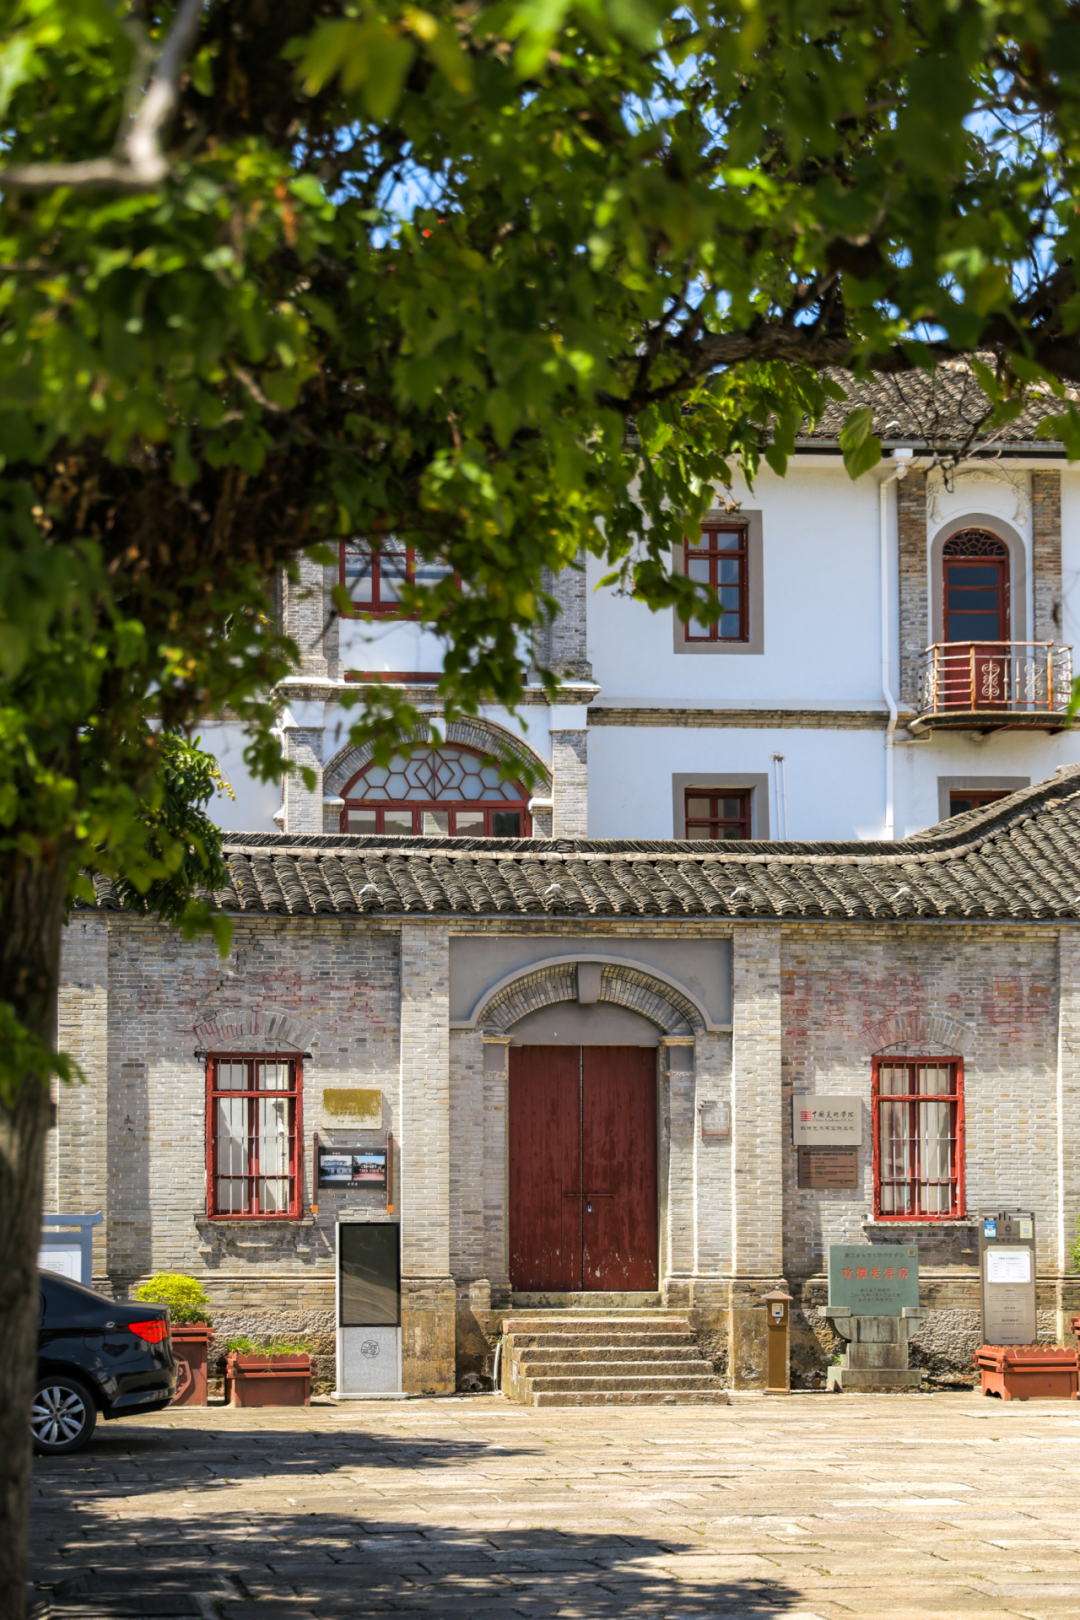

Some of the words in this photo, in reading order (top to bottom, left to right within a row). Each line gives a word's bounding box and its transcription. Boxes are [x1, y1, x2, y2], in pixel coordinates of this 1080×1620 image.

[842, 1266, 909, 1280] 欢潭老洋房
